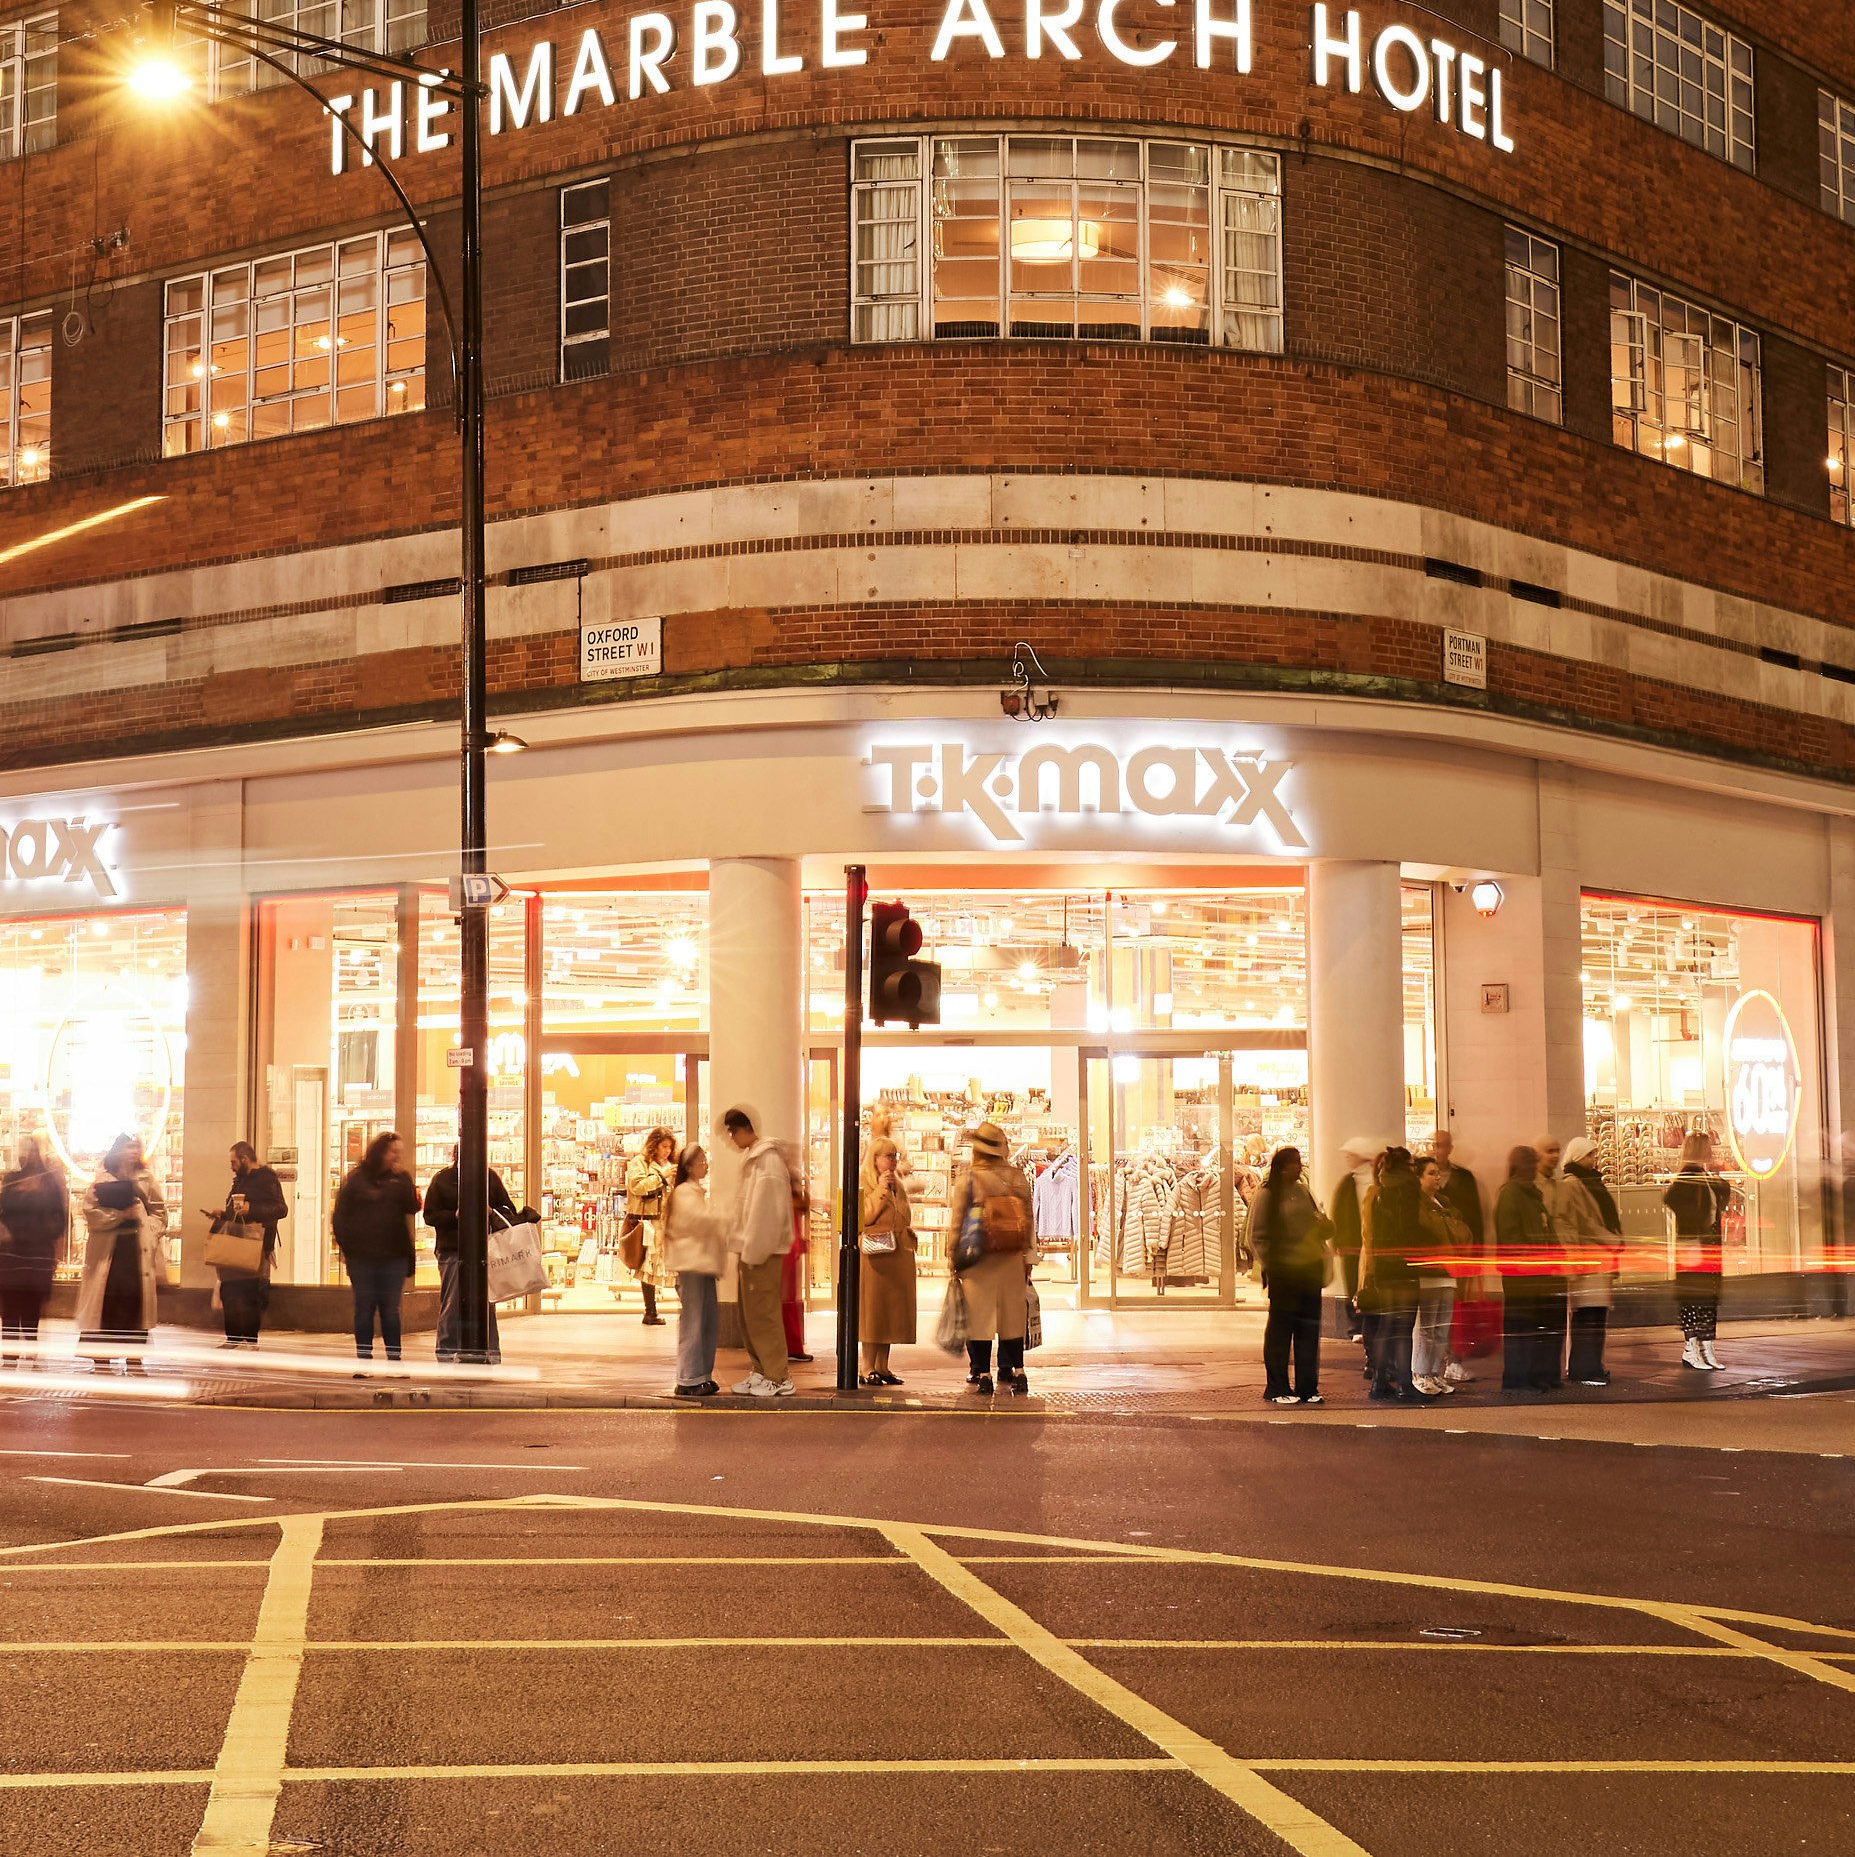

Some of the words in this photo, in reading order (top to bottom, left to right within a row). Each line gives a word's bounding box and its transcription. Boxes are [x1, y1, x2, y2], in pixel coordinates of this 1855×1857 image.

[323, 67, 455, 176] THE
[1309, 0, 1516, 154] HOTEL
[587, 626, 639, 645] OXFORD
[1449, 635, 1481, 655] PORTMAN
[587, 644, 633, 662] STREET
[637, 641, 654, 656] W1
[1449, 651, 1473, 670] STREET
[586, 670, 600, 678] CITY
[600, 668, 608, 676] OF
[609, 664, 650, 675] WESTMINSTER
[469, 879, 487, 902] P
[490, 1249, 533, 1268] RIMARK
